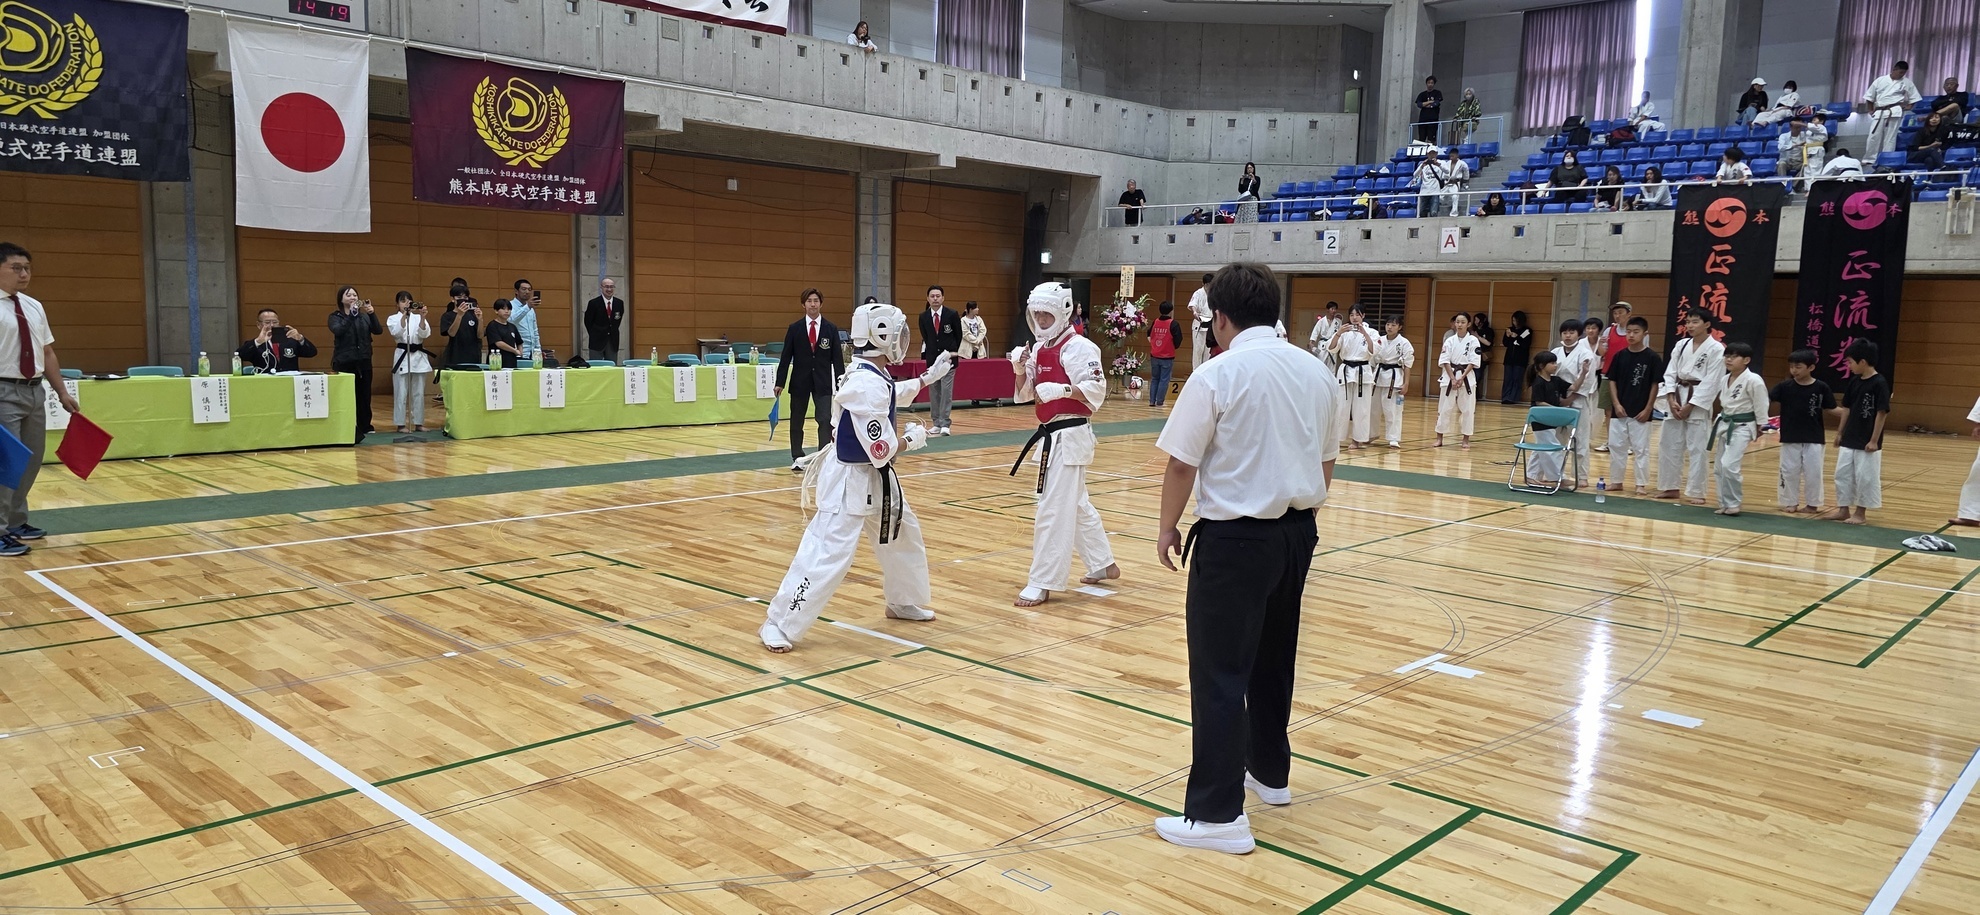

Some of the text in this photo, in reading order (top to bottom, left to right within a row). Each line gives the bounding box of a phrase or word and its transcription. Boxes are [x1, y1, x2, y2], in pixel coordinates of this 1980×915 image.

[0, 23, 82, 96] ATE DO FEDERATION
[449, 178, 597, 205] 熊本県硬式空手道連盟
[1327, 235, 1337, 249] 2
[1443, 233, 1456, 248] A
[1171, 383, 1179, 394] 2
